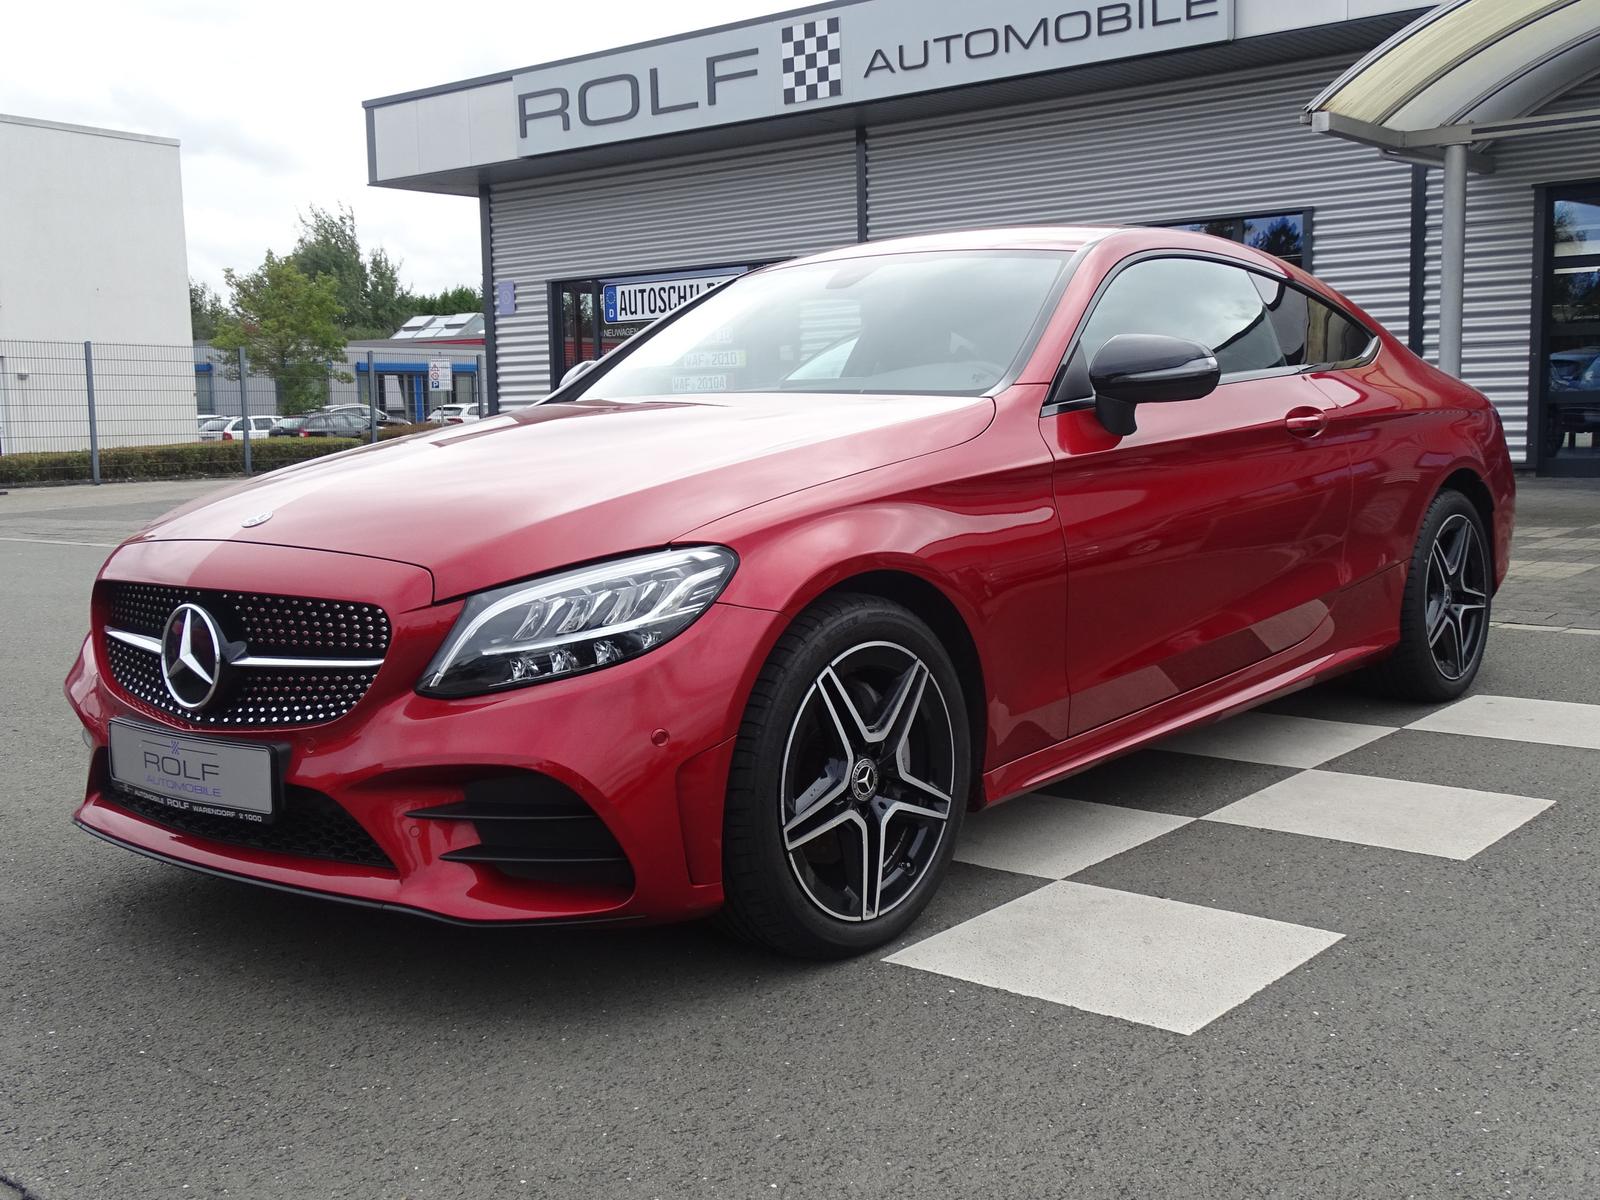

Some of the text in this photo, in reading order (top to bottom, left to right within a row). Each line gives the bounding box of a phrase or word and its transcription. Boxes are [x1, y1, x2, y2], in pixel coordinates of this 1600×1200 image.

[518, 0, 1219, 138] ROLF AUTOMOBILE
[711, 351, 737, 365] 2010
[144, 751, 220, 781] ROLF
[146, 776, 221, 797] AUTOMOBILE
[167, 798, 189, 810] ROLF
[193, 806, 235, 817] WARENDORF
